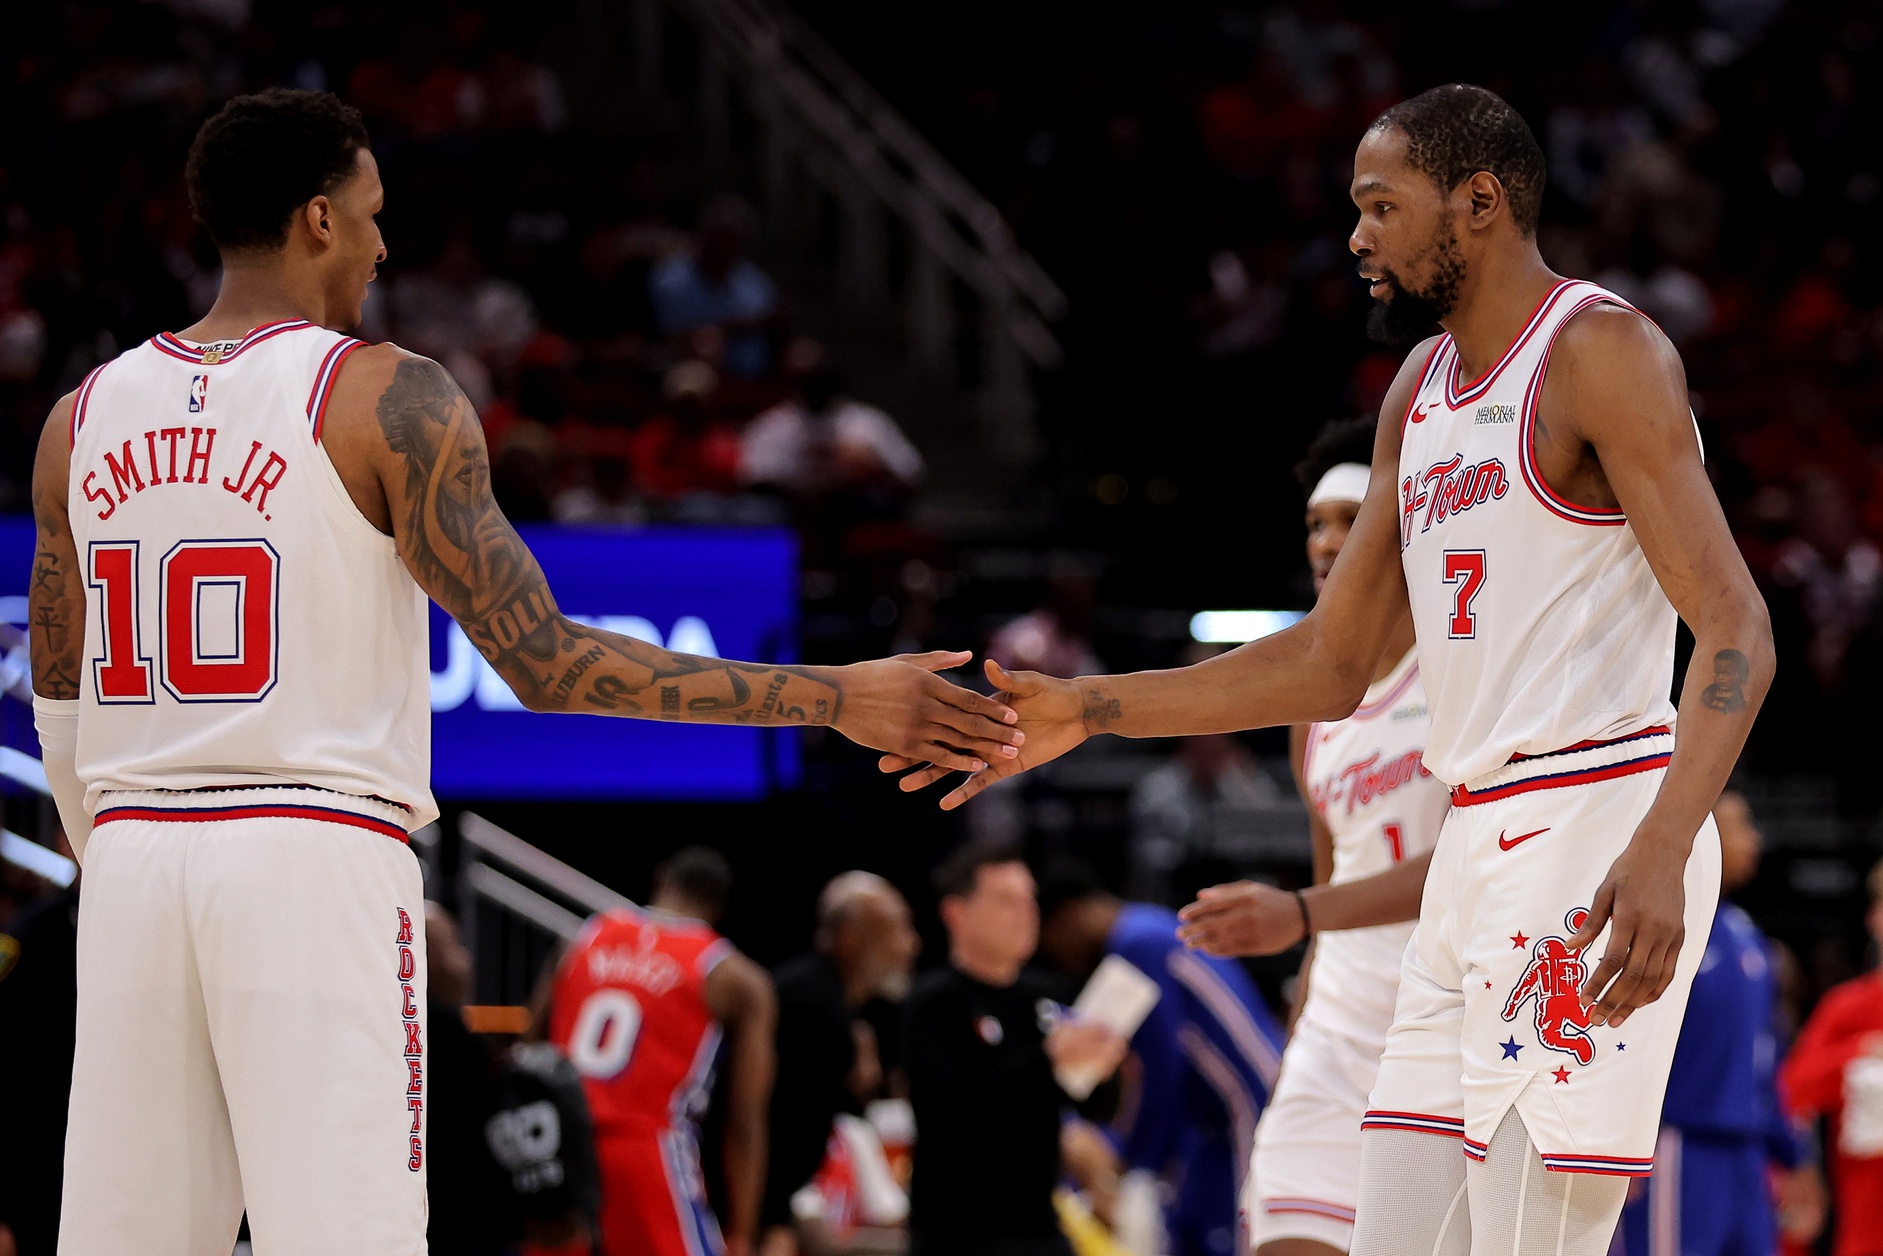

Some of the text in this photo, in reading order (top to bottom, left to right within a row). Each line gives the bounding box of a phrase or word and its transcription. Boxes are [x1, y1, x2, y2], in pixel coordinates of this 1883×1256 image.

[1474, 413, 1515, 425] HERMANN
[1476, 404, 1517, 416] MEMORIAL
[82, 427, 288, 522] SMITH JR.
[87, 538, 281, 705] 10
[1442, 549, 1487, 640] 7
[550, 645, 607, 706] UBURN
[396, 907, 424, 1172] ROCKETS
[570, 987, 642, 1080] 0
